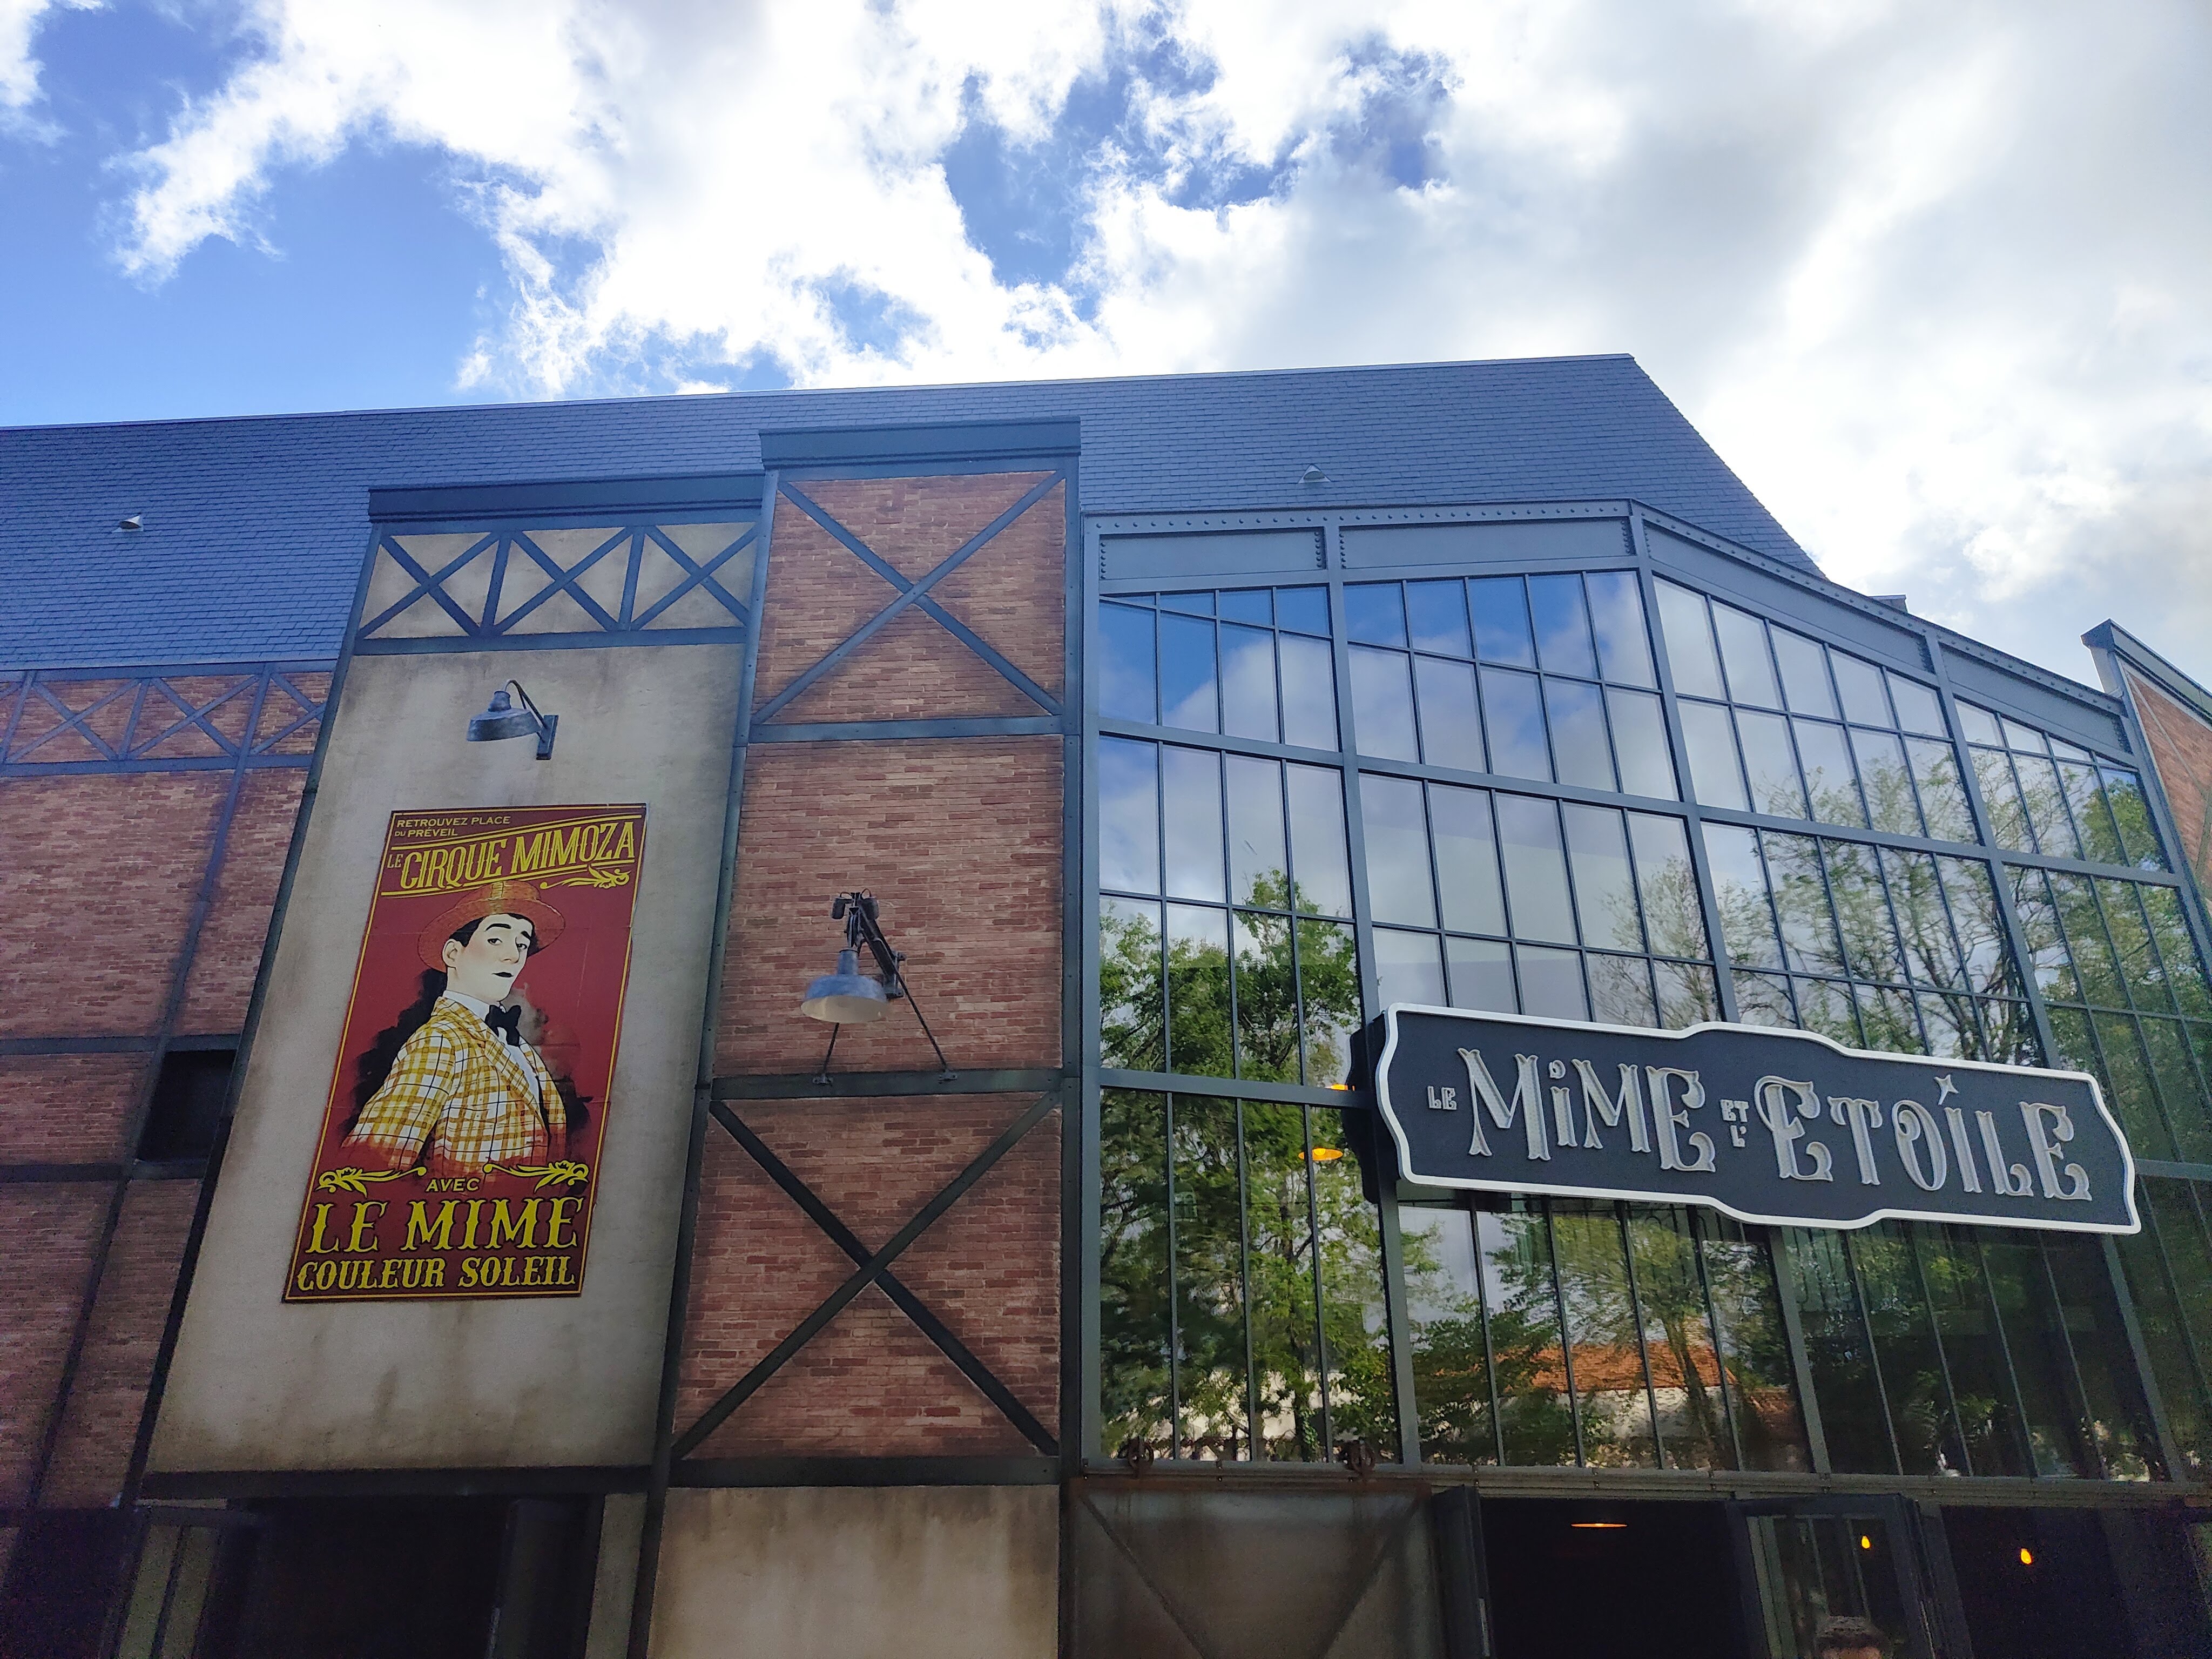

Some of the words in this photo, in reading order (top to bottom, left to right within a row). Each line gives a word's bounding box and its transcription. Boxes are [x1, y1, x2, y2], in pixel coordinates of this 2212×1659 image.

[397, 817, 468, 828] RETROUVEZ
[471, 816, 511, 825] PLACE
[408, 827, 458, 837] PRÉVEIL
[387, 854, 403, 868] LE
[400, 838, 508, 888] CIRQUE
[509, 821, 636, 875] MIMOZA
[1427, 1085, 1457, 1110] LE
[1720, 1098, 1749, 1123] ET
[426, 1178, 480, 1192] AVEC
[305, 1202, 387, 1253] LE
[401, 1197, 584, 1251] MIME
[297, 1257, 445, 1291] COULEUR
[458, 1256, 576, 1287] SOLEIL
